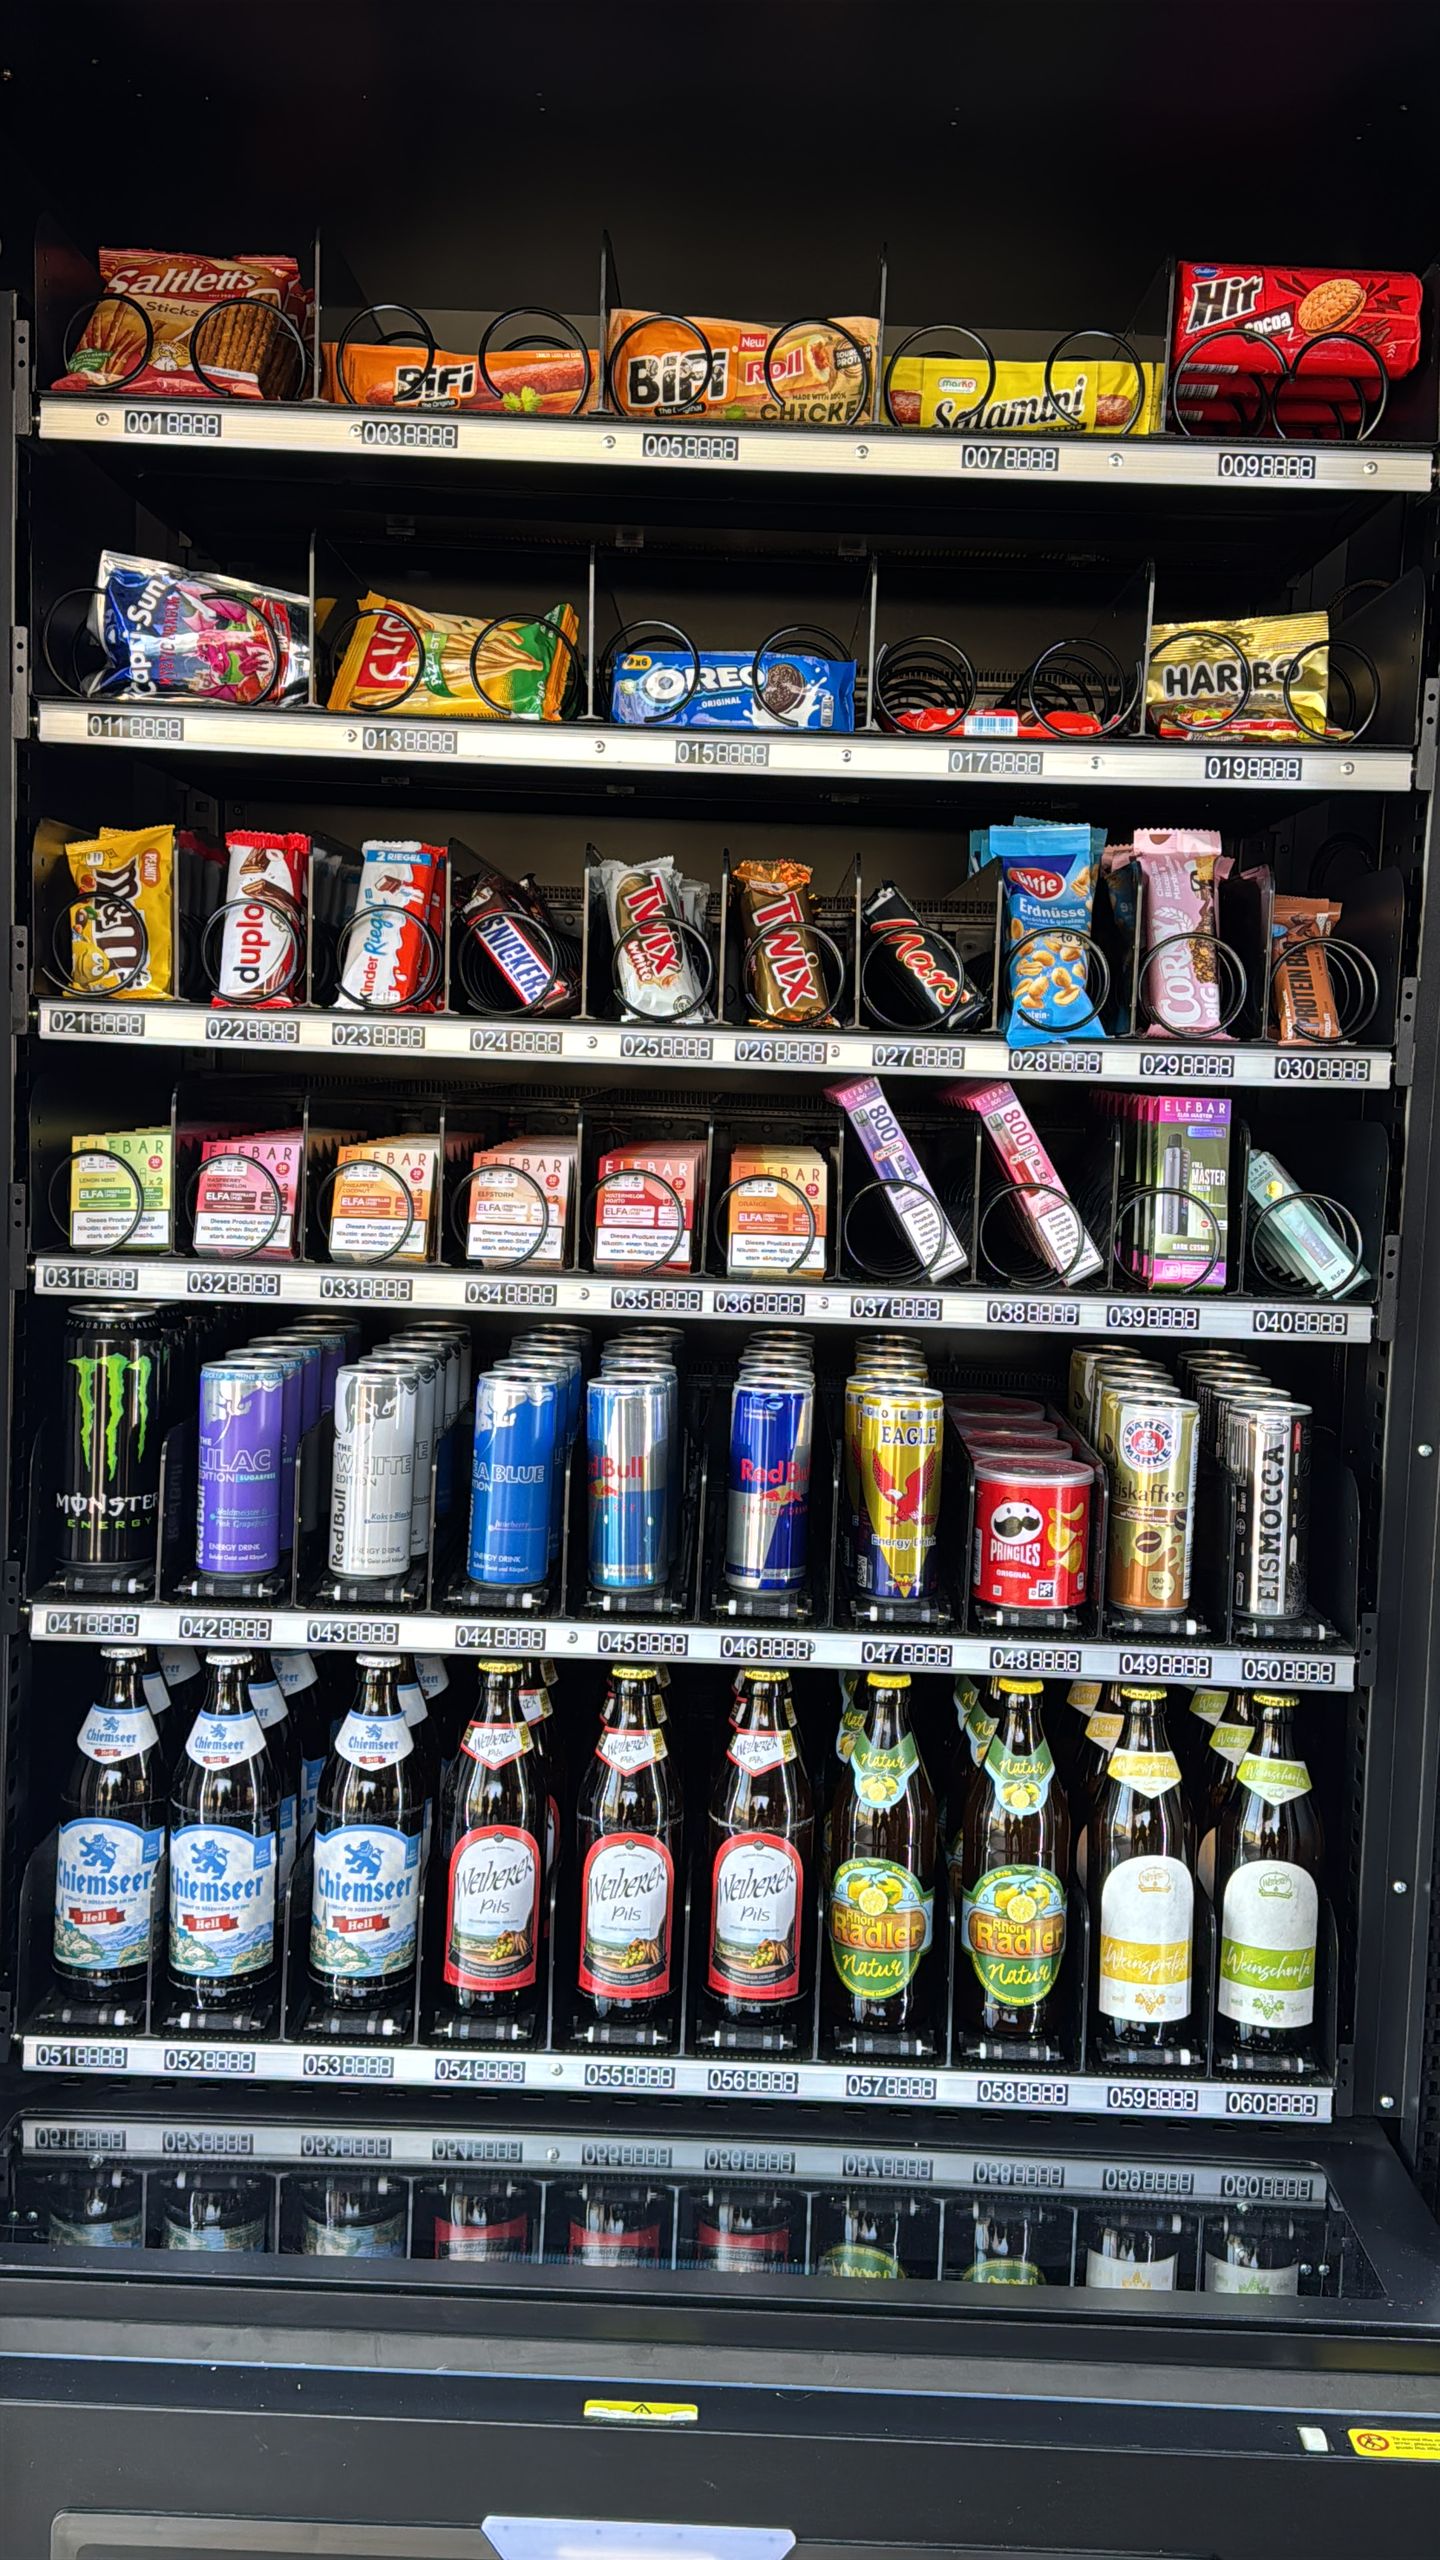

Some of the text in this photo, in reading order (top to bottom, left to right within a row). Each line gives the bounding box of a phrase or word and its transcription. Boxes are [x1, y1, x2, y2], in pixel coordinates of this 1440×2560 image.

[104, 267, 262, 295] Saltletts
[145, 301, 199, 318] Sticks
[1187, 277, 1263, 333] Hit
[741, 335, 766, 349] New
[745, 346, 805, 386] Roll
[126, 576, 166, 694] Capri-Sun
[645, 665, 766, 700] OREO
[1165, 658, 1300, 697] HARIBO
[701, 696, 742, 709] ORIGINAL
[376, 851, 422, 863] 2 RIEGEL
[144, 851, 157, 884] PEANUT
[1019, 897, 1087, 919] Erdnüsse
[232, 902, 271, 984] duplo
[1153, 918, 1202, 1024] CORNY
[1288, 970, 1320, 1029] PROTEIN
[1164, 1101, 1226, 1114] ELFBAR
[868, 1104, 899, 1142] 800
[1003, 1109, 1033, 1146] 800
[156, 1177, 164, 1186] 2
[1191, 1168, 1226, 1186] MASTER
[80, 1190, 104, 1199] ELFA
[206, 1192, 230, 1201] ELFA
[341, 1197, 365, 1206] ELFA
[477, 1203, 502, 1212] ELFA
[605, 1207, 628, 1216] ELFA
[738, 1212, 763, 1222] ELFA
[867, 1407, 939, 1420] GOLDE
[882, 1426, 936, 1447] EAGLE
[1126, 1420, 1173, 1440] BÄREN
[337, 1443, 352, 1452] THE
[1125, 1443, 1171, 1466] MARKE
[199, 1448, 271, 1472] LILAC
[601, 1456, 645, 1478] Bull
[492, 1463, 545, 1484] BLUE
[740, 1458, 784, 1483] Red
[1113, 1477, 1185, 1504] Eiskaffee
[67, 1518, 152, 1530] ENERGY
[332, 1488, 346, 1568] Red Bull
[1258, 1443, 1285, 1602] EISMOCCA
[208, 1542, 260, 1552] ENERGY DRINK
[871, 1534, 911, 1548] Energy
[990, 1538, 1041, 1568] PRINGLES
[996, 1568, 1032, 1580] ORIGINAL
[86, 1727, 137, 1744] Chiemseer
[194, 1735, 245, 1750] Chiemseer
[348, 1735, 399, 1750] Chiemseer
[861, 1750, 907, 1770] Natur
[999, 1757, 1047, 1776] Natur
[58, 1862, 152, 1896] Chiemseer
[172, 1866, 264, 1902] Chiemseer
[318, 1868, 413, 1903] Chiemseer
[82, 1908, 107, 1924] Hell
[479, 1898, 511, 1915] Pils
[610, 1905, 642, 1923] Pils
[739, 1905, 771, 1923] Pils
[196, 1917, 221, 1930] Hell
[348, 1918, 373, 1931] Hell
[847, 1911, 876, 1927] Rhön
[992, 1919, 1025, 1935] Rhön
[833, 1911, 923, 1950] Radler
[975, 1919, 1064, 1956] Radler
[842, 1953, 905, 1978] Natur
[988, 1963, 1051, 1985] Natur
